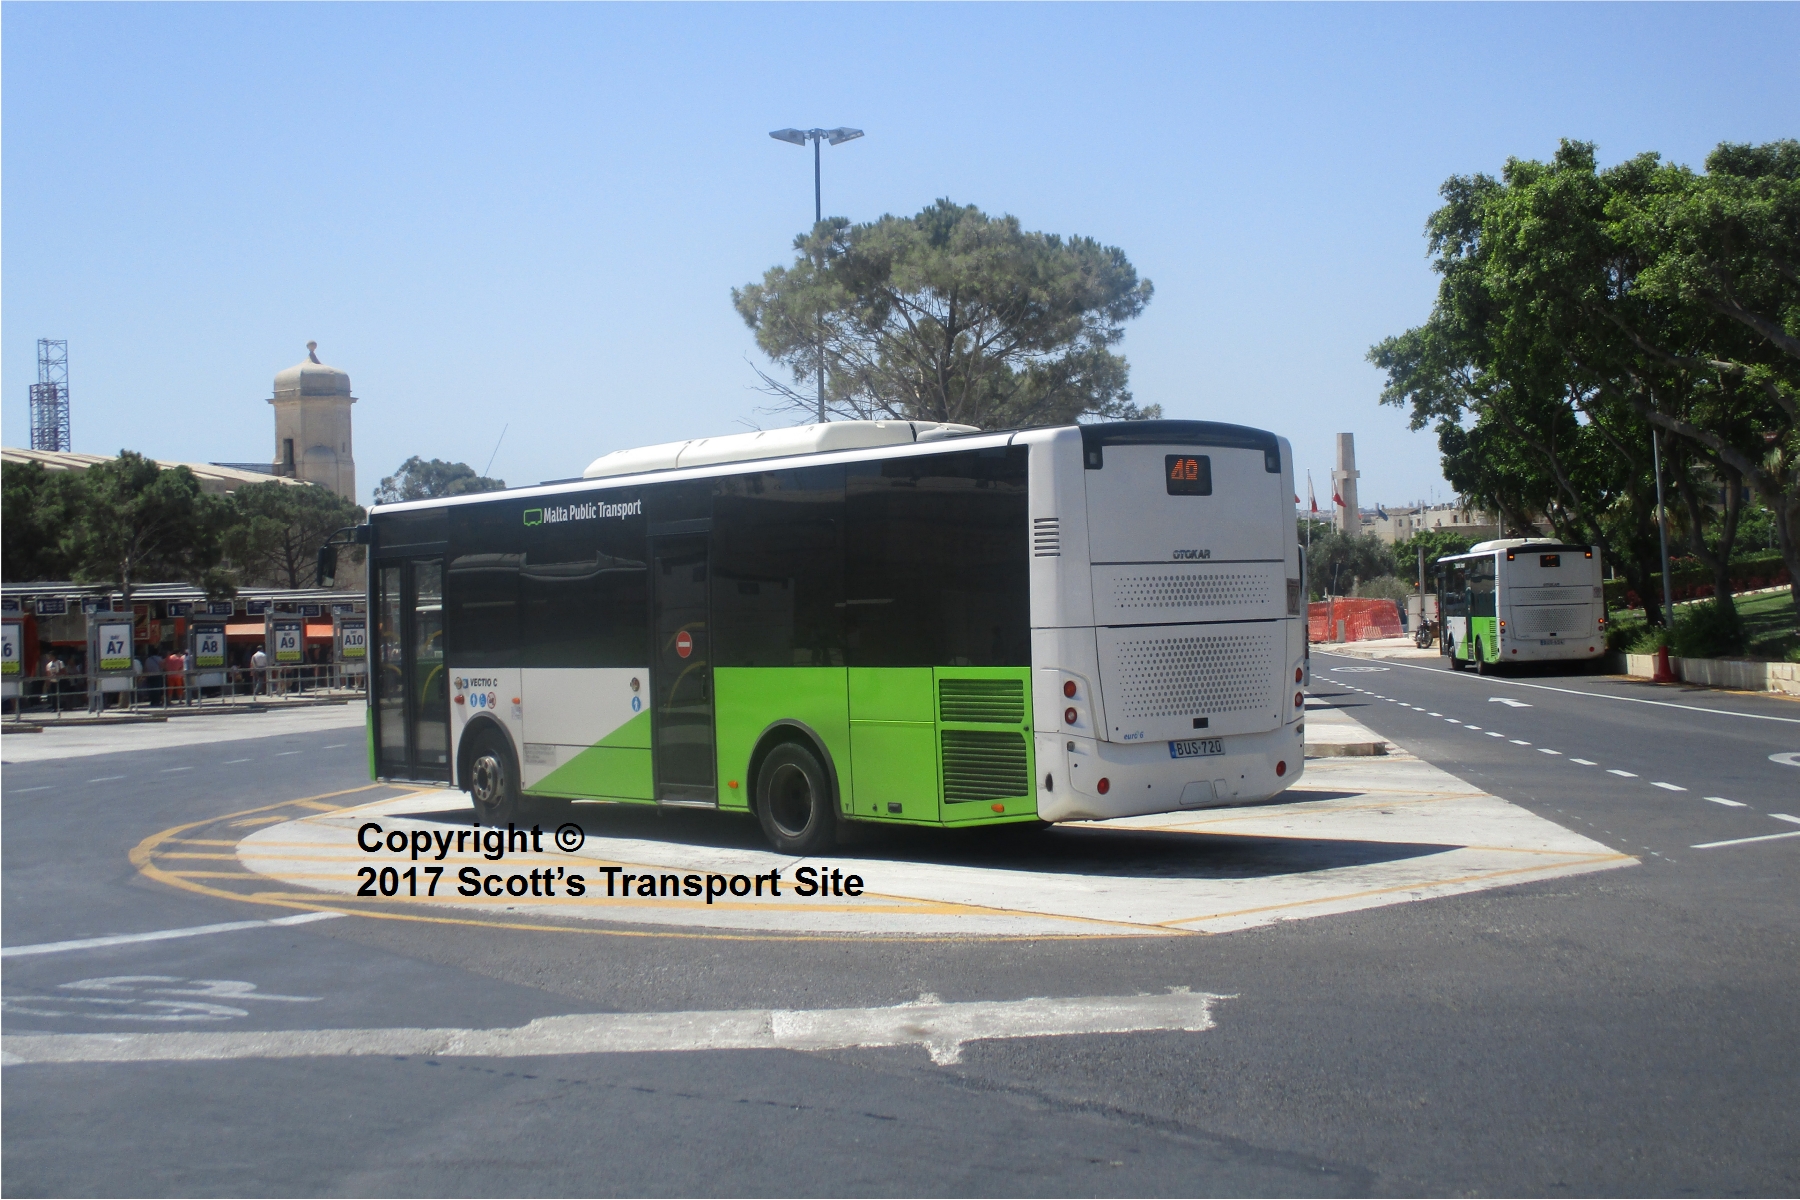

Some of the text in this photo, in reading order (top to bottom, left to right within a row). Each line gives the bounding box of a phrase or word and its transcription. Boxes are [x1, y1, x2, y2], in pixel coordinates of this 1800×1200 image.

[544, 499, 641, 523] Malta Public Transport
[1173, 549, 1211, 559] OTOKAR
[280, 637, 295, 648] A9
[344, 634, 363, 645] A10
[1, 642, 13, 657] 6
[106, 641, 124, 654] A7
[202, 640, 218, 653] A8
[470, 678, 498, 687] VECTIO C
